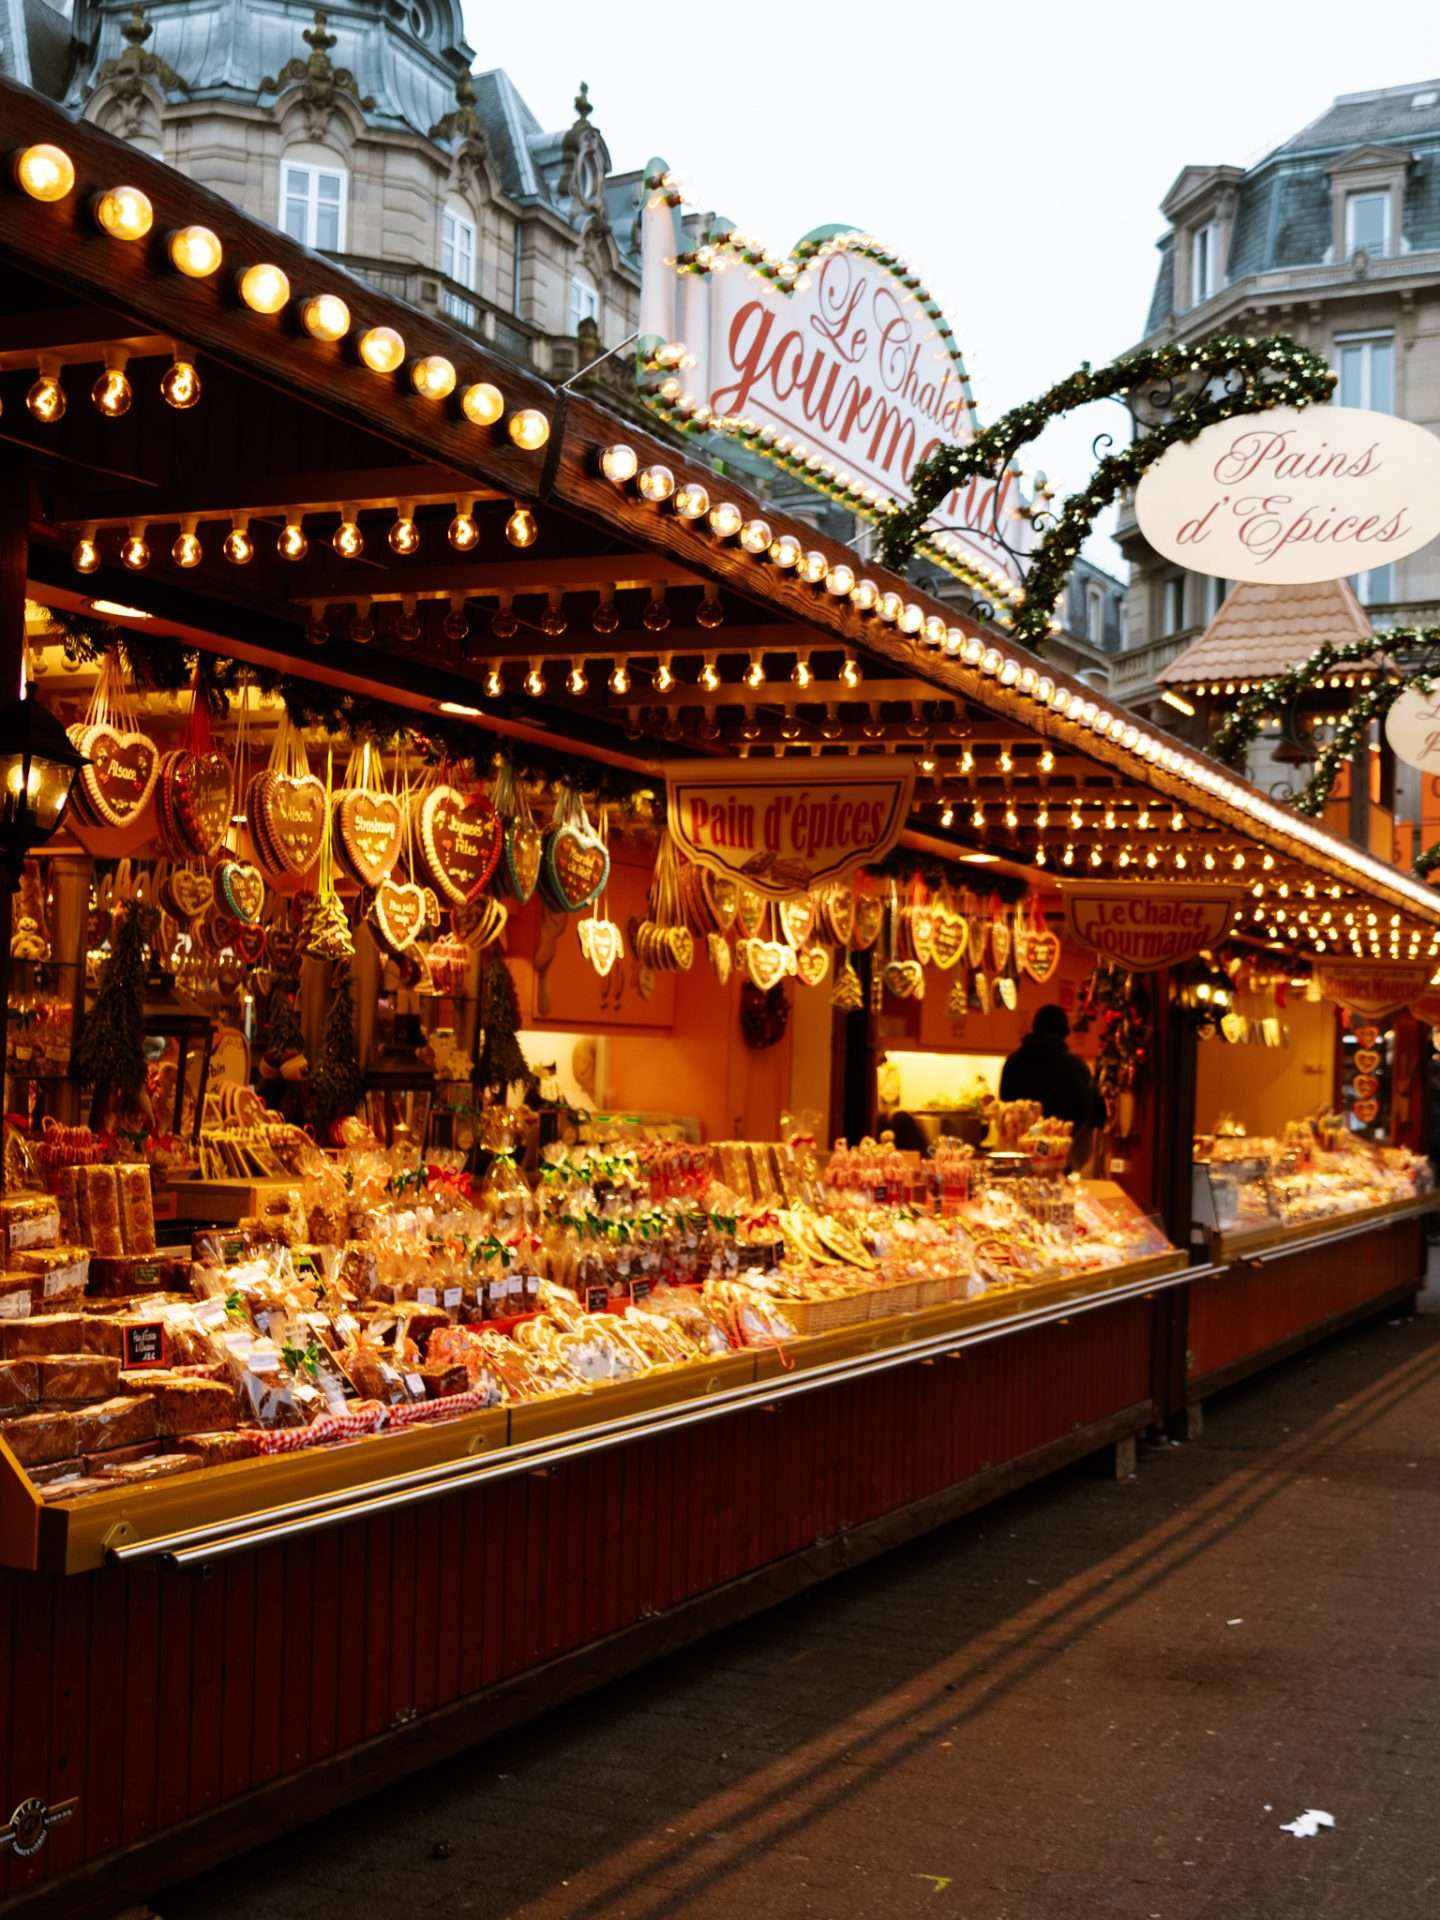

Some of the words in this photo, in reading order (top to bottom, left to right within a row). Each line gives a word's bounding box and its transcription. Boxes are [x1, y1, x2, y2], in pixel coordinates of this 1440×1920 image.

[810, 251, 867, 363] Le
[873, 287, 965, 438] Chalet
[709, 301, 1013, 550] gourmnd
[1213, 430, 1383, 485] Pains
[1176, 495, 1413, 566] d'Epices
[107, 759, 138, 782] Alsace
[689, 796, 755, 850] Pain
[764, 792, 885, 859] d'épices
[1085, 920, 1212, 957] Gourmand
[1097, 903, 1126, 926] Le
[1128, 899, 1205, 930] Chalet
